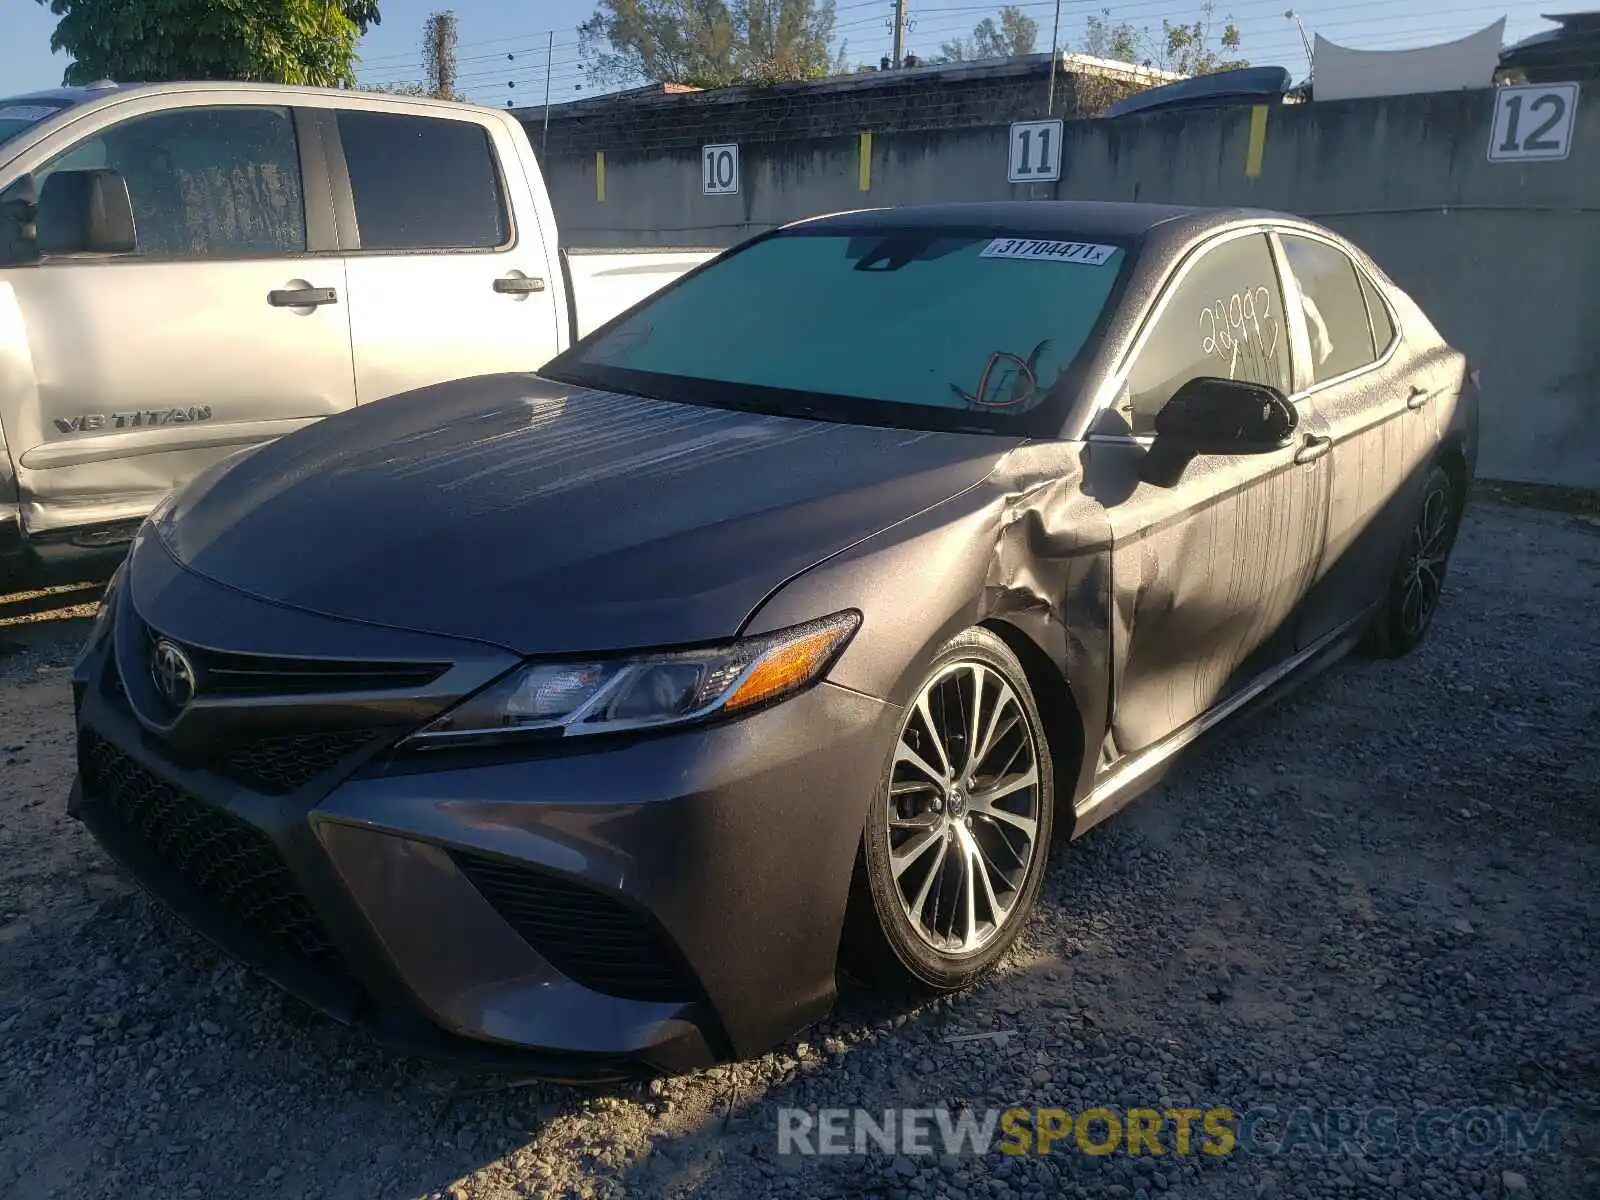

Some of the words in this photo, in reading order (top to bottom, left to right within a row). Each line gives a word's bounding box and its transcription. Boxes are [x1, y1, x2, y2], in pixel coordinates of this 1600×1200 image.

[1500, 94, 1565, 151] 12
[706, 151, 733, 188] 10
[1017, 129, 1051, 174] 11
[1199, 286, 1278, 361] 22993
[53, 413, 106, 433] V8
[111, 404, 212, 428] TITAN
